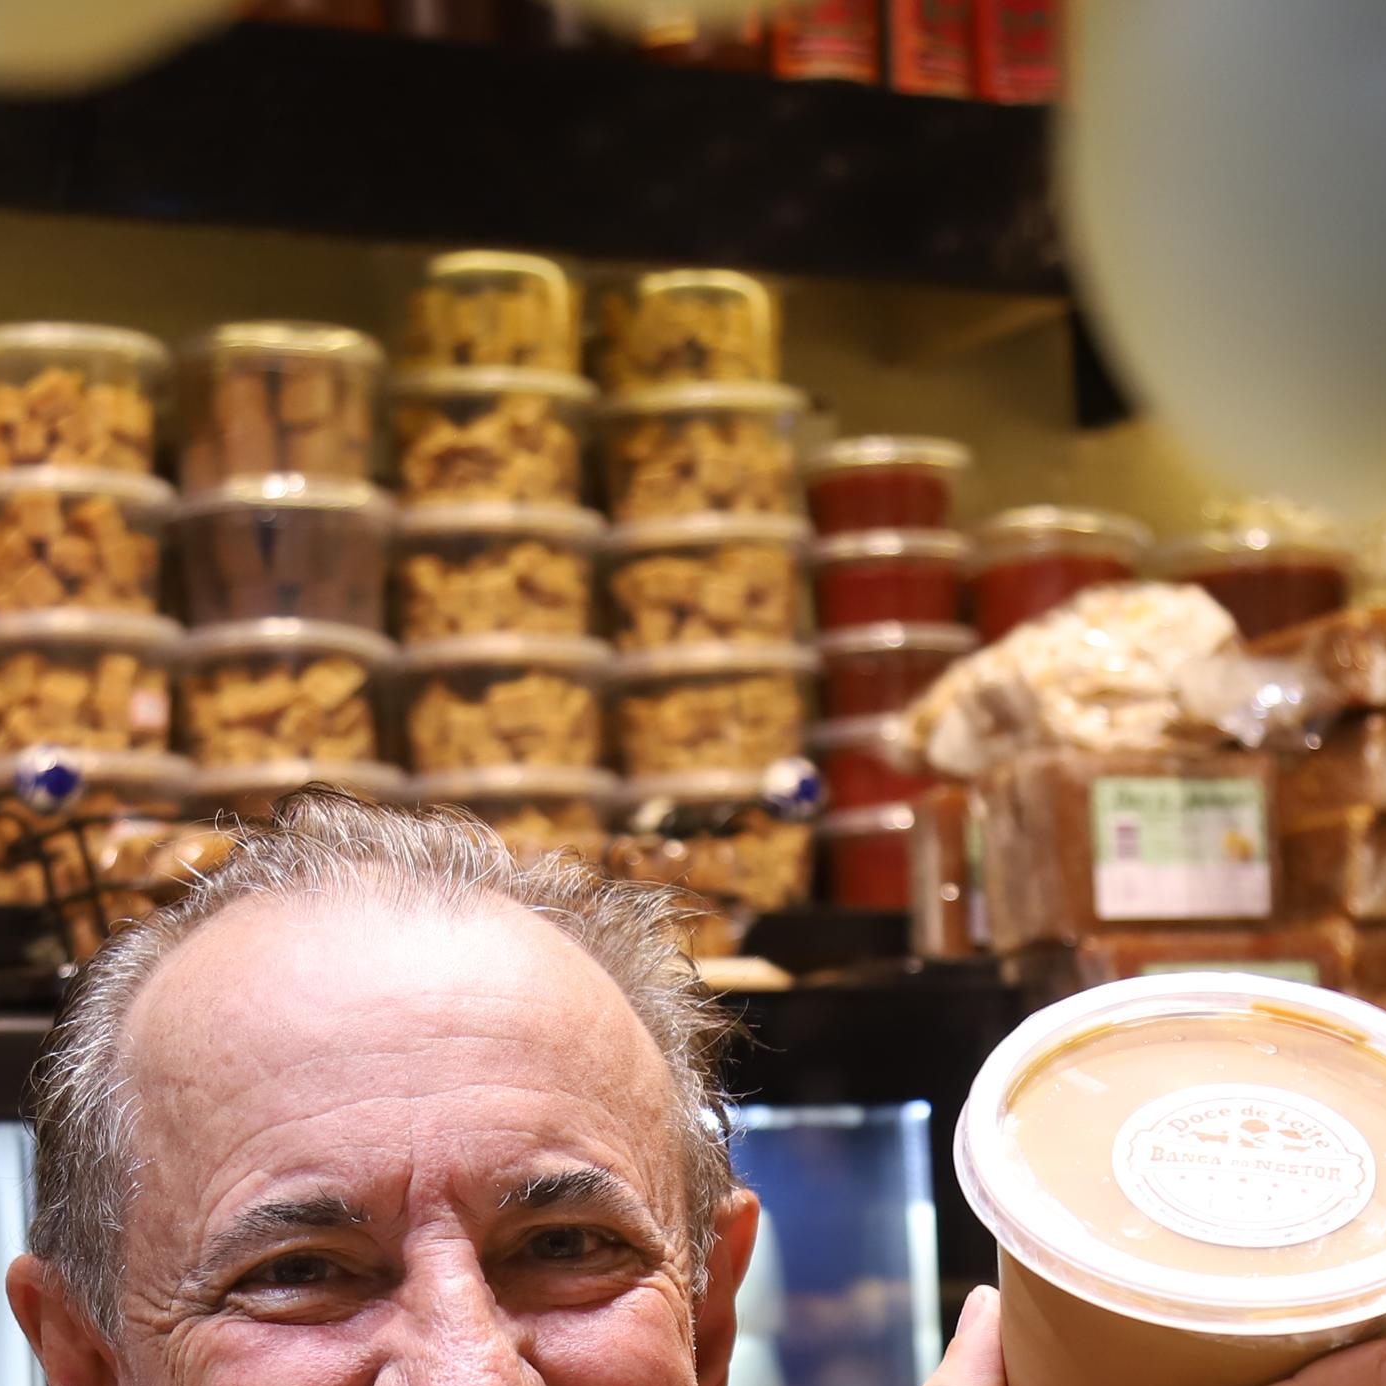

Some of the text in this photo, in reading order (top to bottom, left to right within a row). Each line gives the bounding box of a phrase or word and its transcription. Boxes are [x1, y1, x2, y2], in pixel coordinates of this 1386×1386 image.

[1167, 1104, 1331, 1149] Doce de Leite
[1150, 1144, 1222, 1166] BANCA
[1253, 1158, 1343, 1183] NESTOR
